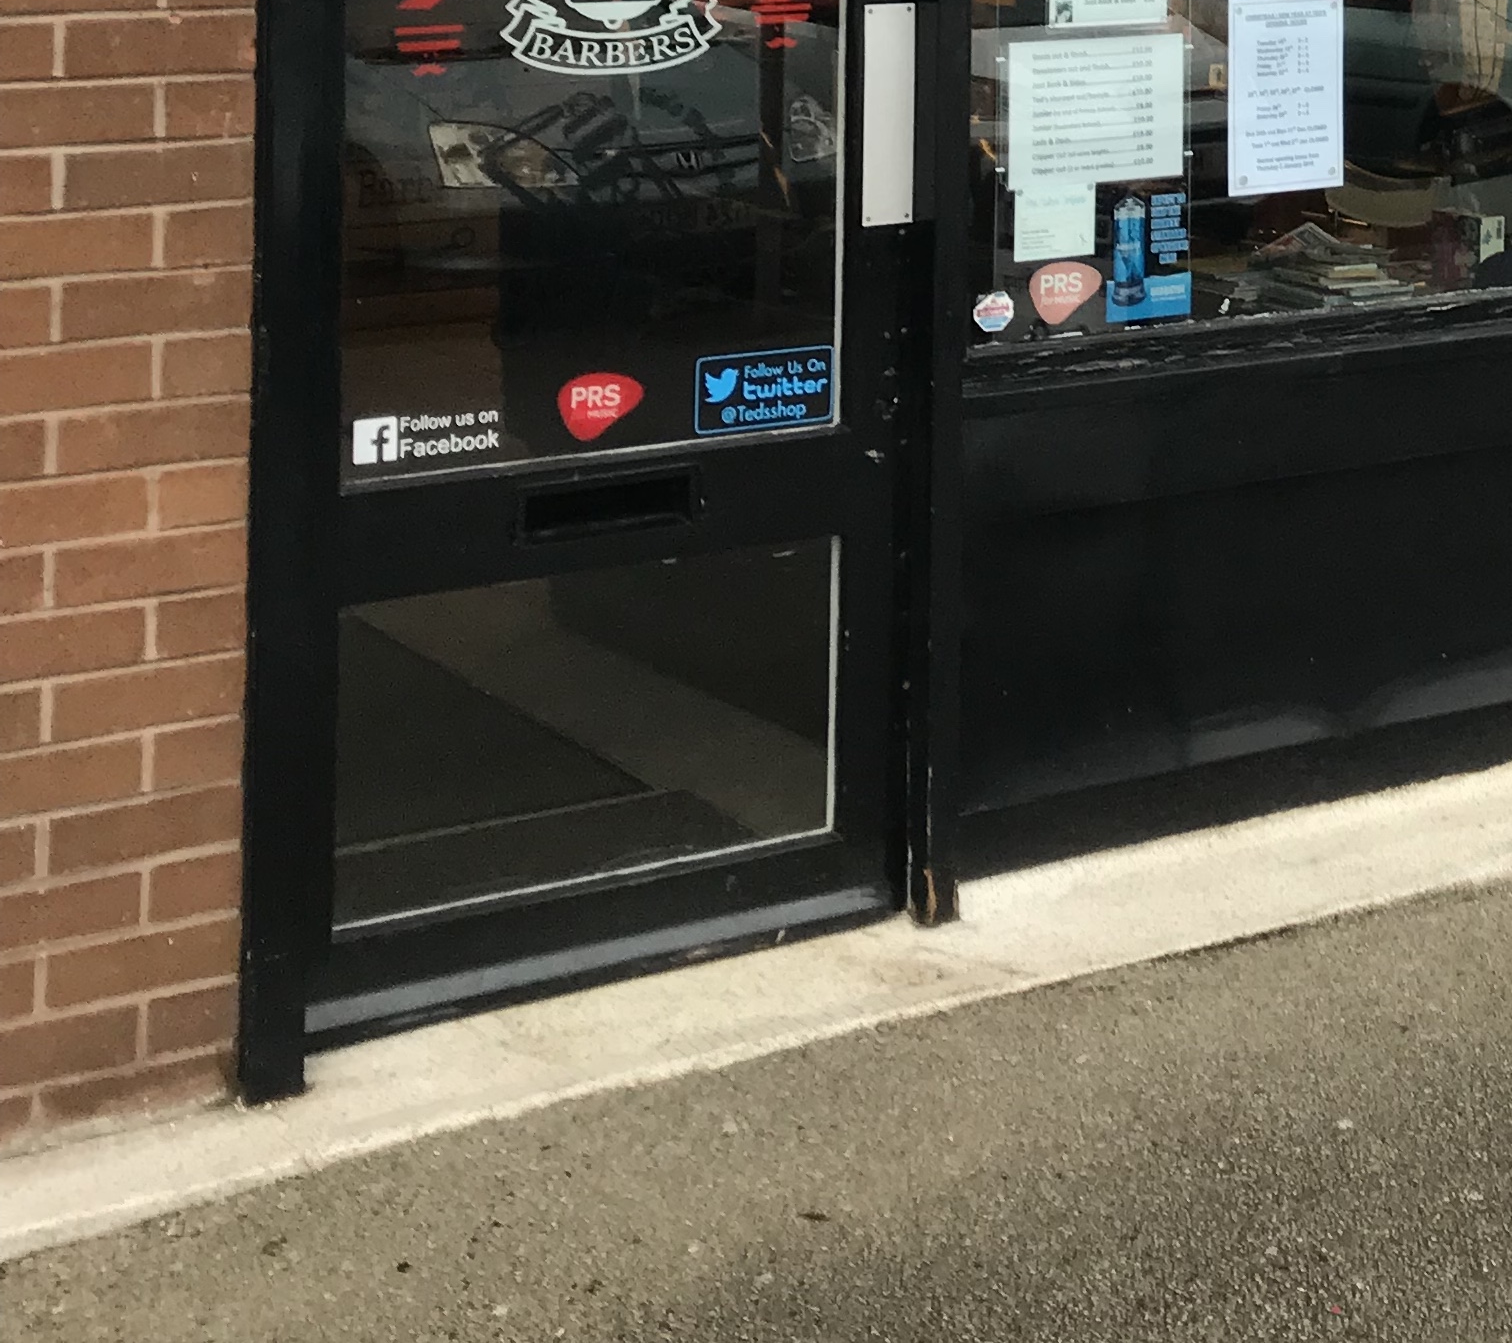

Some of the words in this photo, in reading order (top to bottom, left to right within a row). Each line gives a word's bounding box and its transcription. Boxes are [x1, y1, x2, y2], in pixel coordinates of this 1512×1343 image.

[528, 28, 695, 67] BARBERS
[1040, 272, 1083, 294] PRS
[744, 362, 783, 379] Follow
[787, 360, 803, 374] Us
[807, 358, 826, 372] On
[571, 384, 621, 409] PRS
[742, 376, 828, 400] twitter
[400, 414, 452, 433] Follow
[455, 412, 475, 427] us
[478, 410, 499, 424] on
[721, 400, 806, 424] @Tedsshop
[400, 429, 499, 458] Facebook
